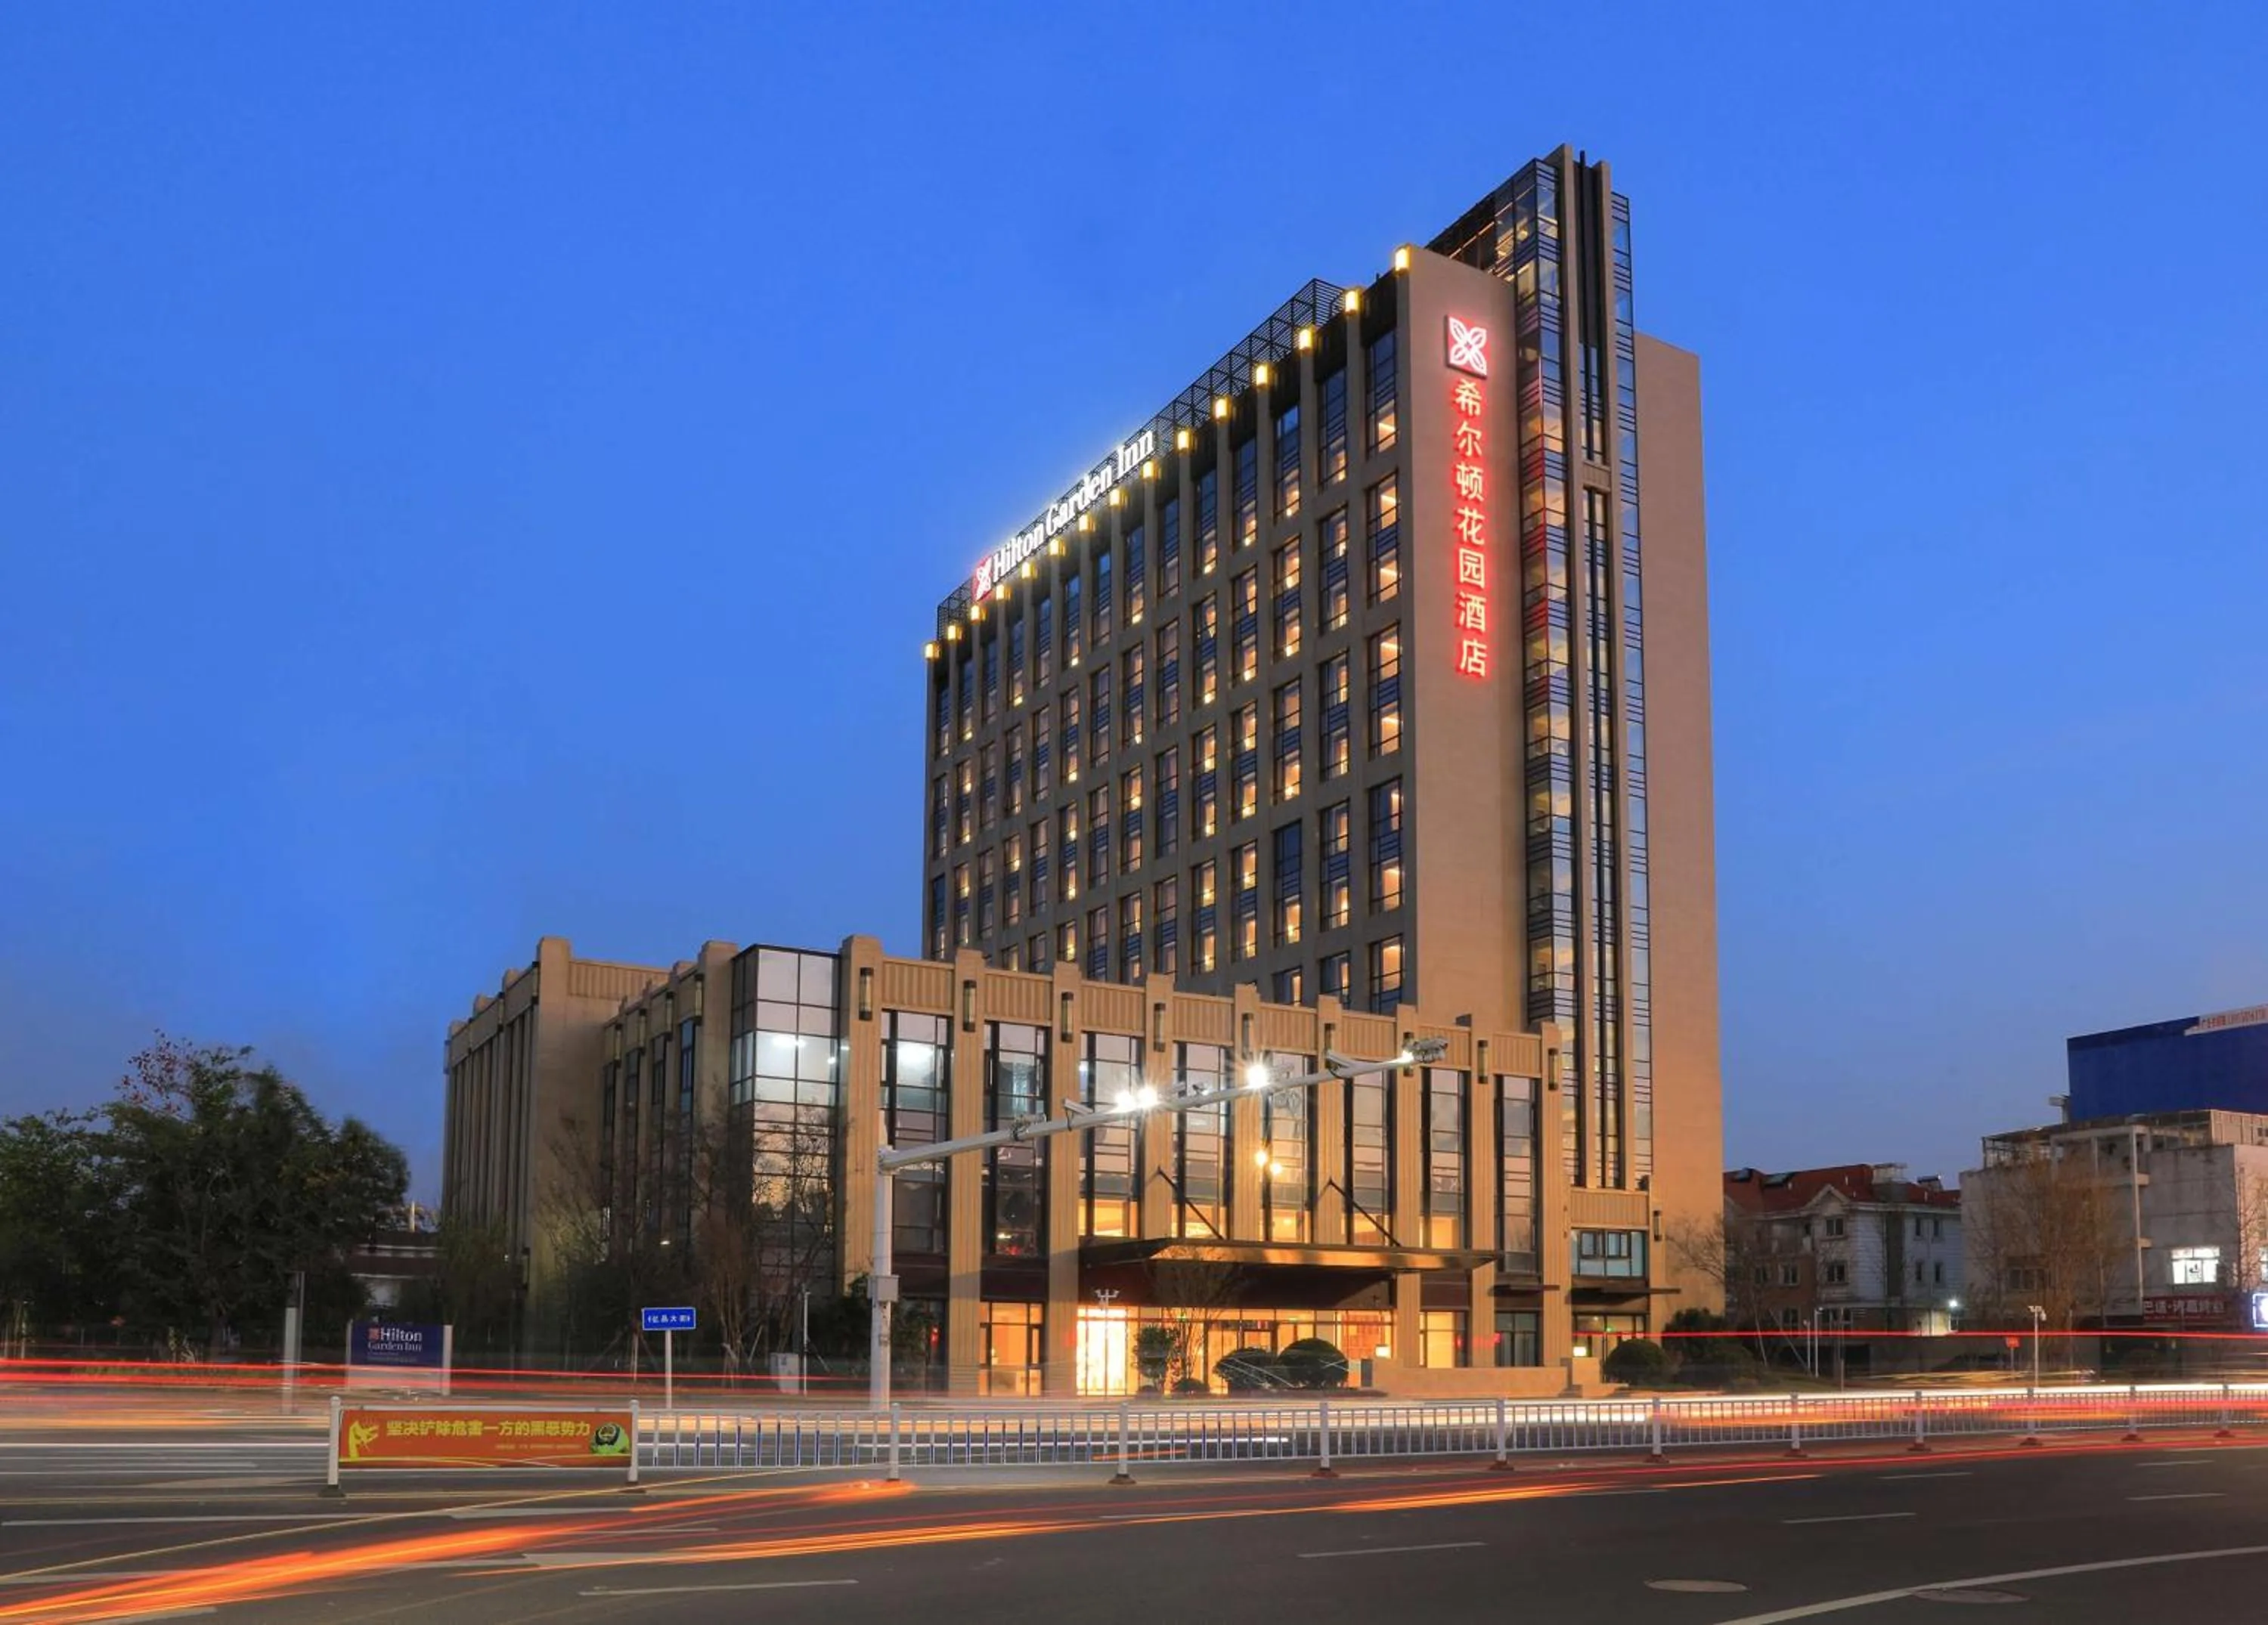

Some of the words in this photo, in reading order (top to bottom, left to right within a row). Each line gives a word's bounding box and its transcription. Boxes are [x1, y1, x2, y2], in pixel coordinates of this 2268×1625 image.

[992, 521, 1045, 583] Hilton
[1046, 464, 1114, 536] Garden
[1115, 429, 1155, 479] Inn
[1455, 378, 1489, 678] 希尔顿花园酒店
[380, 1326, 423, 1342] Hilton
[367, 1341, 404, 1351] Garden
[386, 1419, 590, 1436] 坚决铲除危害一方的黑恶势力
